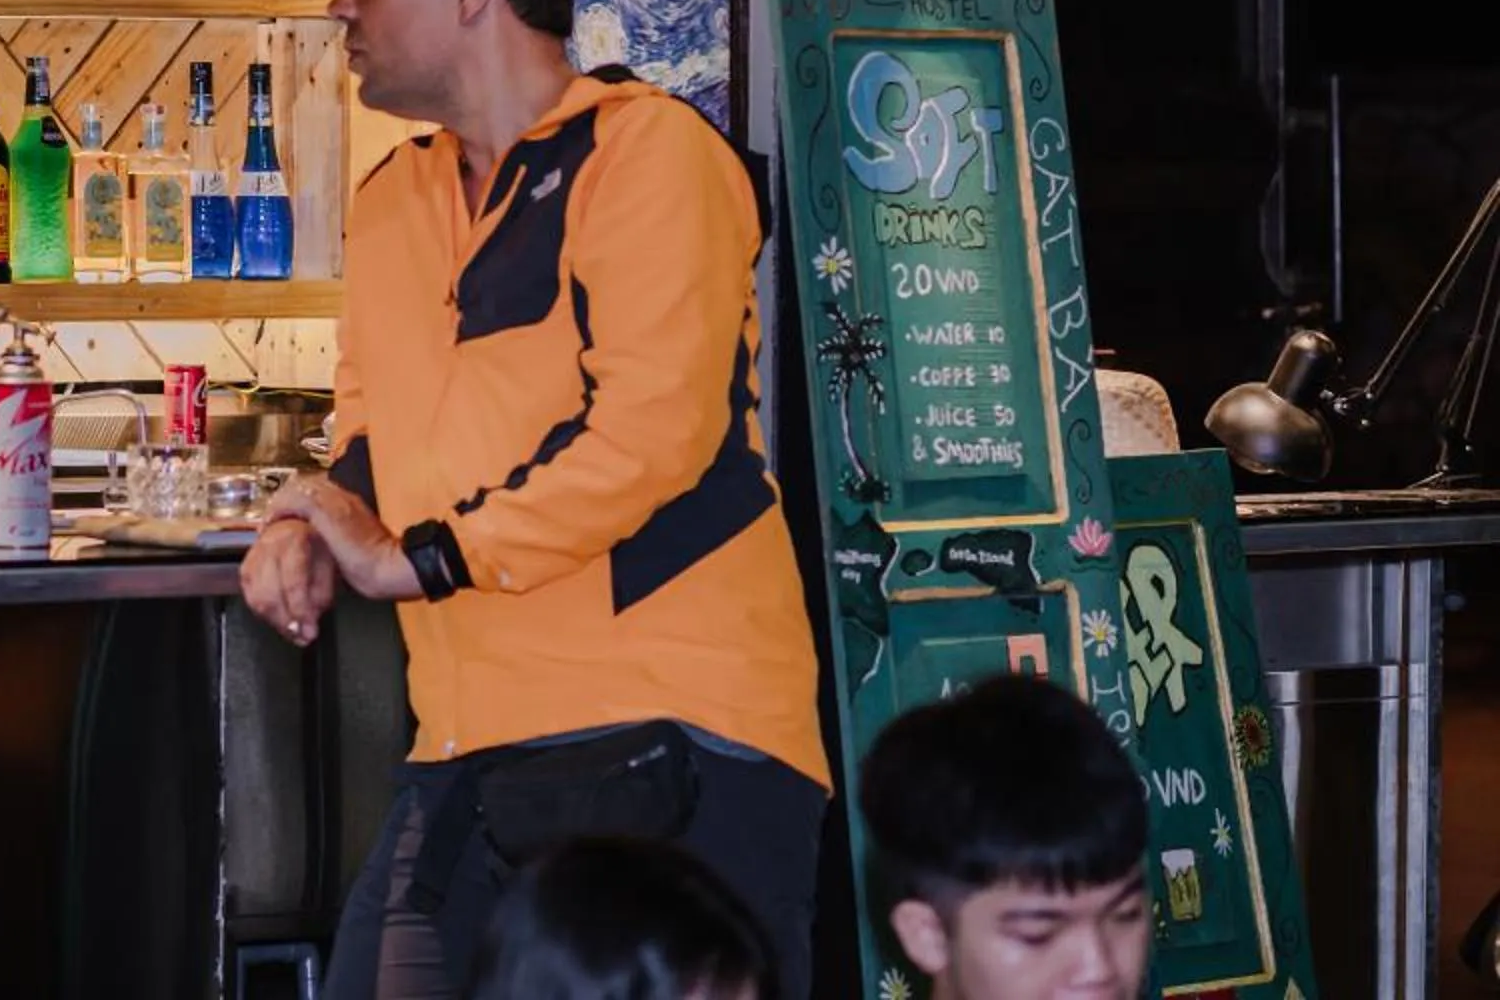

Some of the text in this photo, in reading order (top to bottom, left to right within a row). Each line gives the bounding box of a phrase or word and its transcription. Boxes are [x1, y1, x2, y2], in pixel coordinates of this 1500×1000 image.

[934, 268, 980, 295] VND
[910, 322, 976, 345] WATER
[1154, 767, 1207, 808] VND
